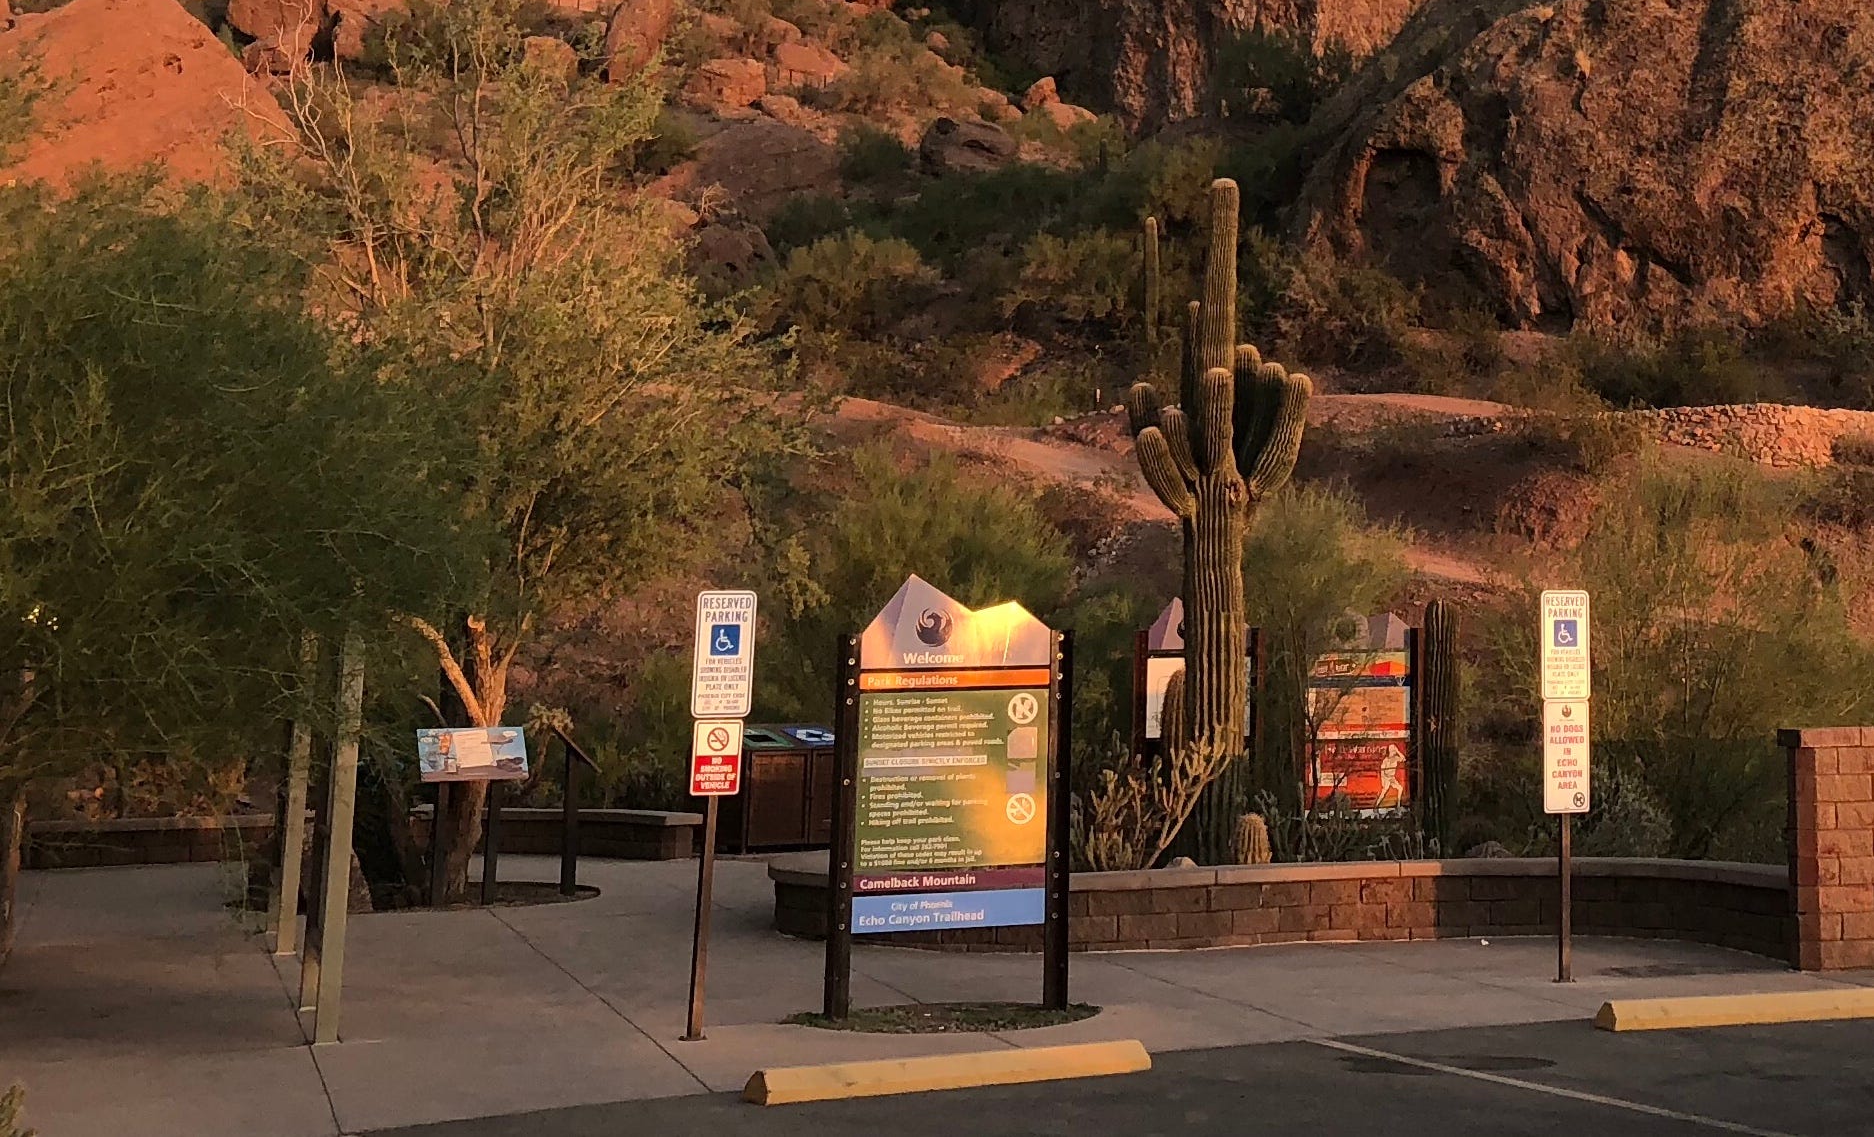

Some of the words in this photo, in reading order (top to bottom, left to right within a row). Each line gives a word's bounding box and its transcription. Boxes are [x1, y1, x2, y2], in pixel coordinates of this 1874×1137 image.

[703, 597, 752, 610] RESERVED
[1545, 596, 1585, 607] RESERVED
[705, 610, 748, 623] PARKING
[1548, 607, 1583, 618] PARKING
[903, 651, 964, 665] Welcome
[867, 676, 890, 686] Park
[896, 674, 958, 688] Regulations
[903, 706, 935, 714] permitted
[924, 714, 957, 722] containers
[959, 712, 995, 721] prohibited.
[958, 721, 989, 729] required.
[1551, 725, 1561, 733] NO
[1563, 725, 1584, 733] DOGS
[872, 741, 908, 749] designated
[910, 740, 935, 748] parking
[963, 738, 982, 746] paved
[983, 737, 1004, 745] roads.
[1549, 736, 1584, 744] ALLOWED
[1563, 748, 1571, 756] IN
[712, 756, 722, 764] NO
[952, 756, 986, 764] ENFORCED
[1557, 758, 1578, 767] ECHO
[700, 765, 732, 773] SMOKING
[695, 773, 725, 781] OUTSIDE
[919, 774, 946, 782] removal
[1552, 769, 1583, 779] CANYON
[701, 781, 730, 789] VEHICLE
[869, 783, 906, 792] prohibited.
[1557, 781, 1578, 790] AREA
[887, 791, 923, 800] prohibited.
[900, 800, 923, 808] and/or
[892, 809, 929, 817] prohibited.
[868, 819, 890, 827] Hiking
[917, 815, 954, 825] prohibited.
[860, 877, 919, 889] Camelback
[922, 874, 976, 887] Mountain
[891, 902, 907, 912] City
[910, 901, 918, 910] of
[920, 899, 953, 909] Phoenix
[859, 915, 886, 926] Echo
[888, 913, 930, 926] Canyon
[933, 909, 985, 923] Trailhead
